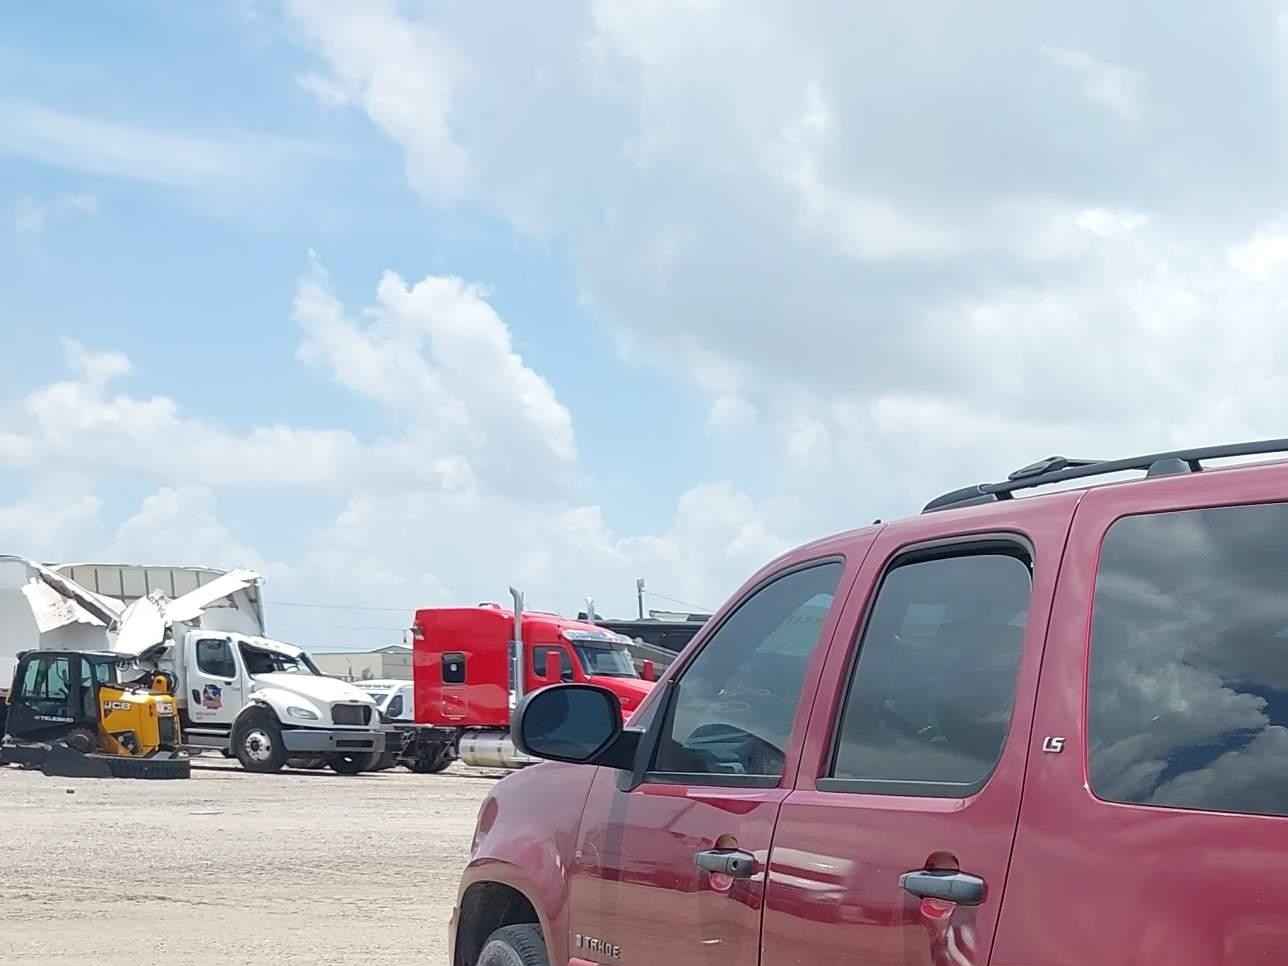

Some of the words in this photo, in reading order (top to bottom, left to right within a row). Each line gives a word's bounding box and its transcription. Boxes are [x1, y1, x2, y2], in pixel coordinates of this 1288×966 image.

[104, 701, 131, 710] JCB
[1042, 736, 1065, 753] LS
[584, 936, 621, 959] TAHOE
